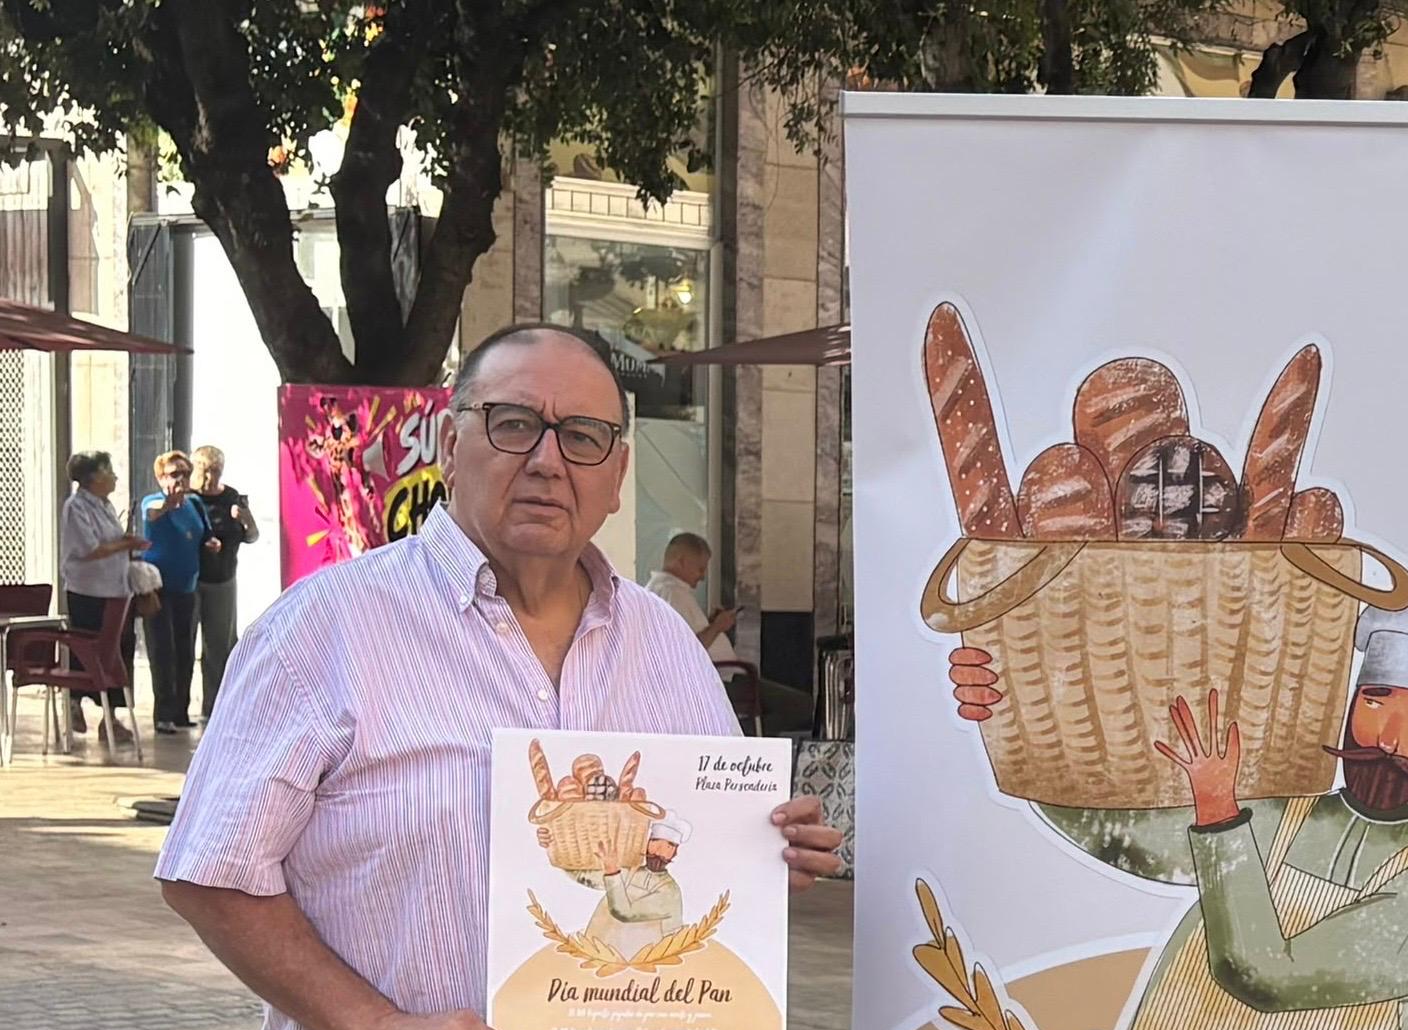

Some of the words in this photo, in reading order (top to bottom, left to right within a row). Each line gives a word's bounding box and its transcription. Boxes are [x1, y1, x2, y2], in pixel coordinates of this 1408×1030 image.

[698, 755, 711, 772] 17
[713, 755, 727, 772] de
[730, 755, 773, 777] octubre
[548, 977, 579, 1003] Día
[583, 976, 661, 1004] mundial
[664, 977, 695, 1004] del
[698, 979, 732, 1004] Pan
